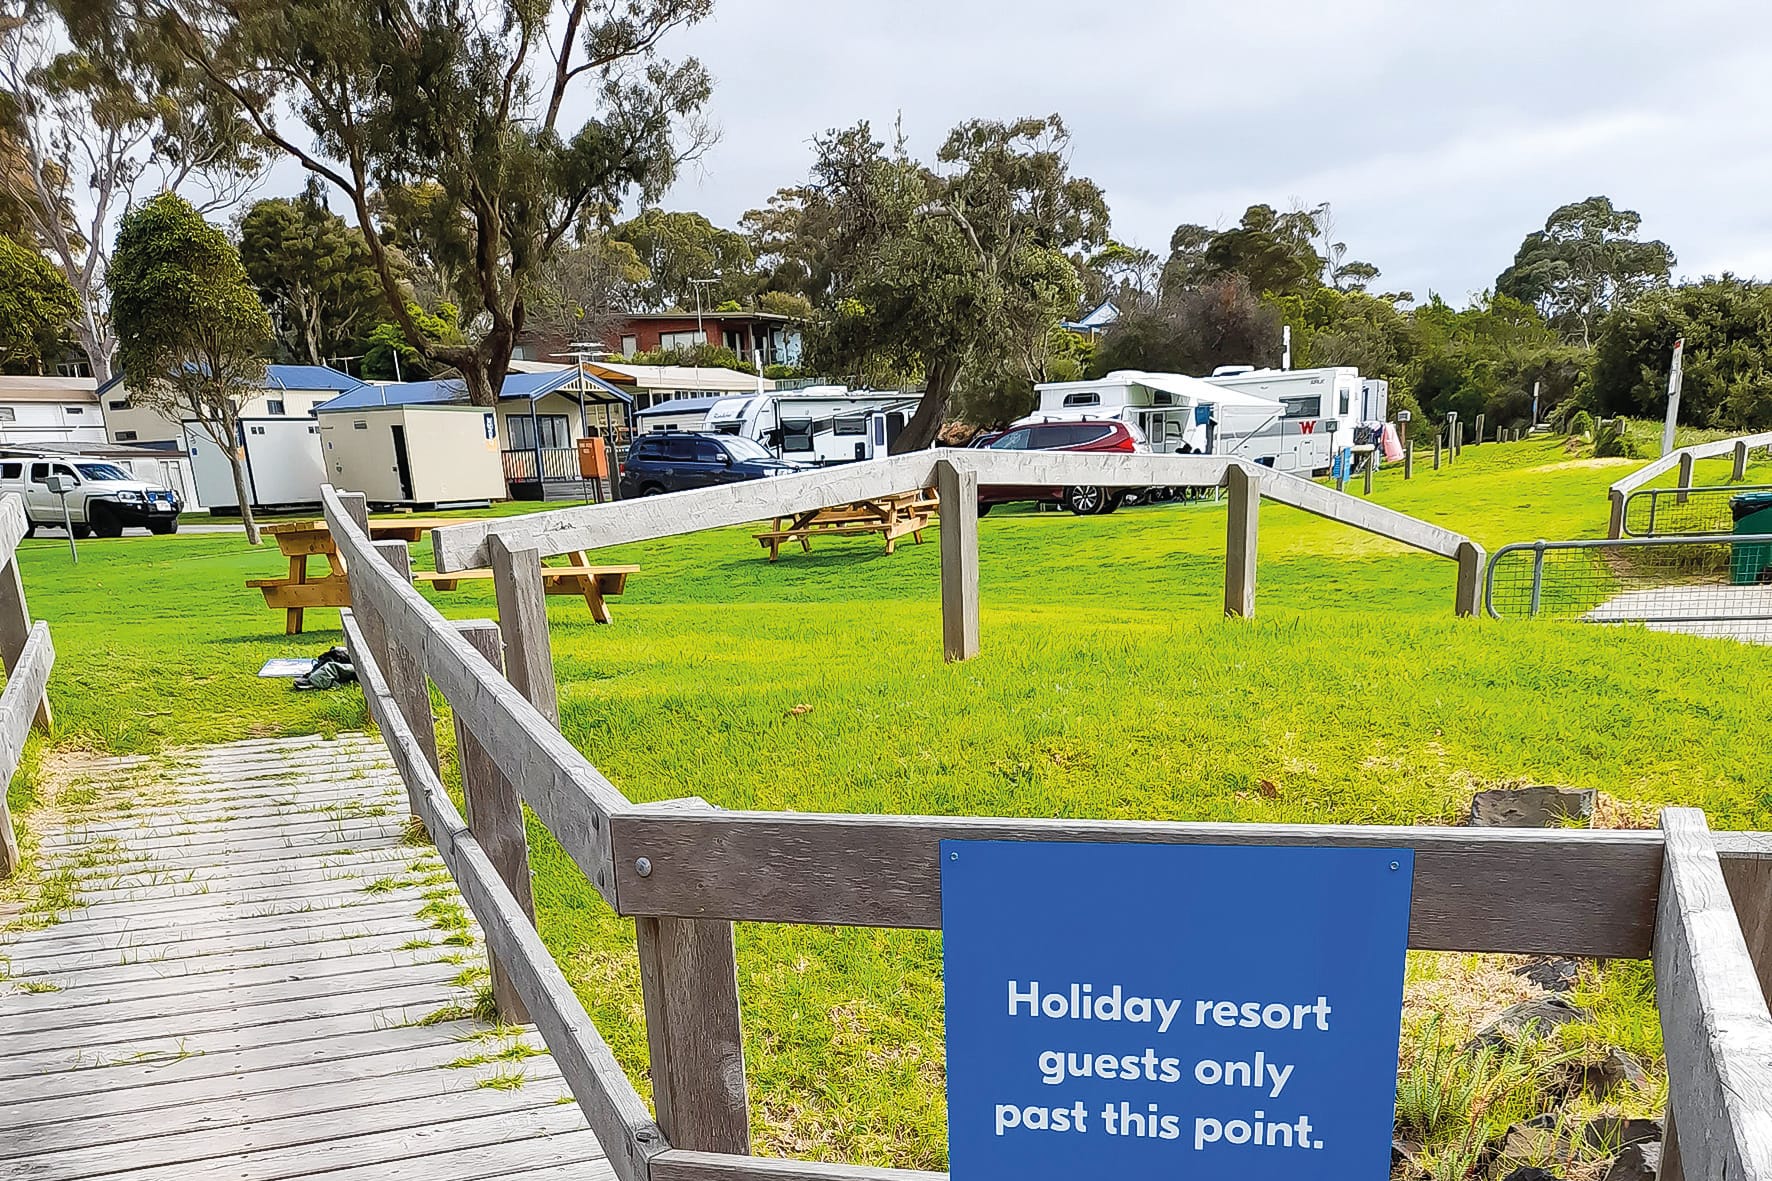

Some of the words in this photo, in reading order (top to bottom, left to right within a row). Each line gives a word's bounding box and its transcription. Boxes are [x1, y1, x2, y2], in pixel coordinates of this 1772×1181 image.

[1299, 420, 1317, 435] W
[1008, 980, 1182, 1033] Holiday
[1195, 996, 1332, 1031] resort
[1038, 1048, 1181, 1085] guests
[1194, 1051, 1295, 1098] only
[995, 1101, 1088, 1136] past
[1101, 1101, 1180, 1140] this
[1194, 1110, 1324, 1150] point.
